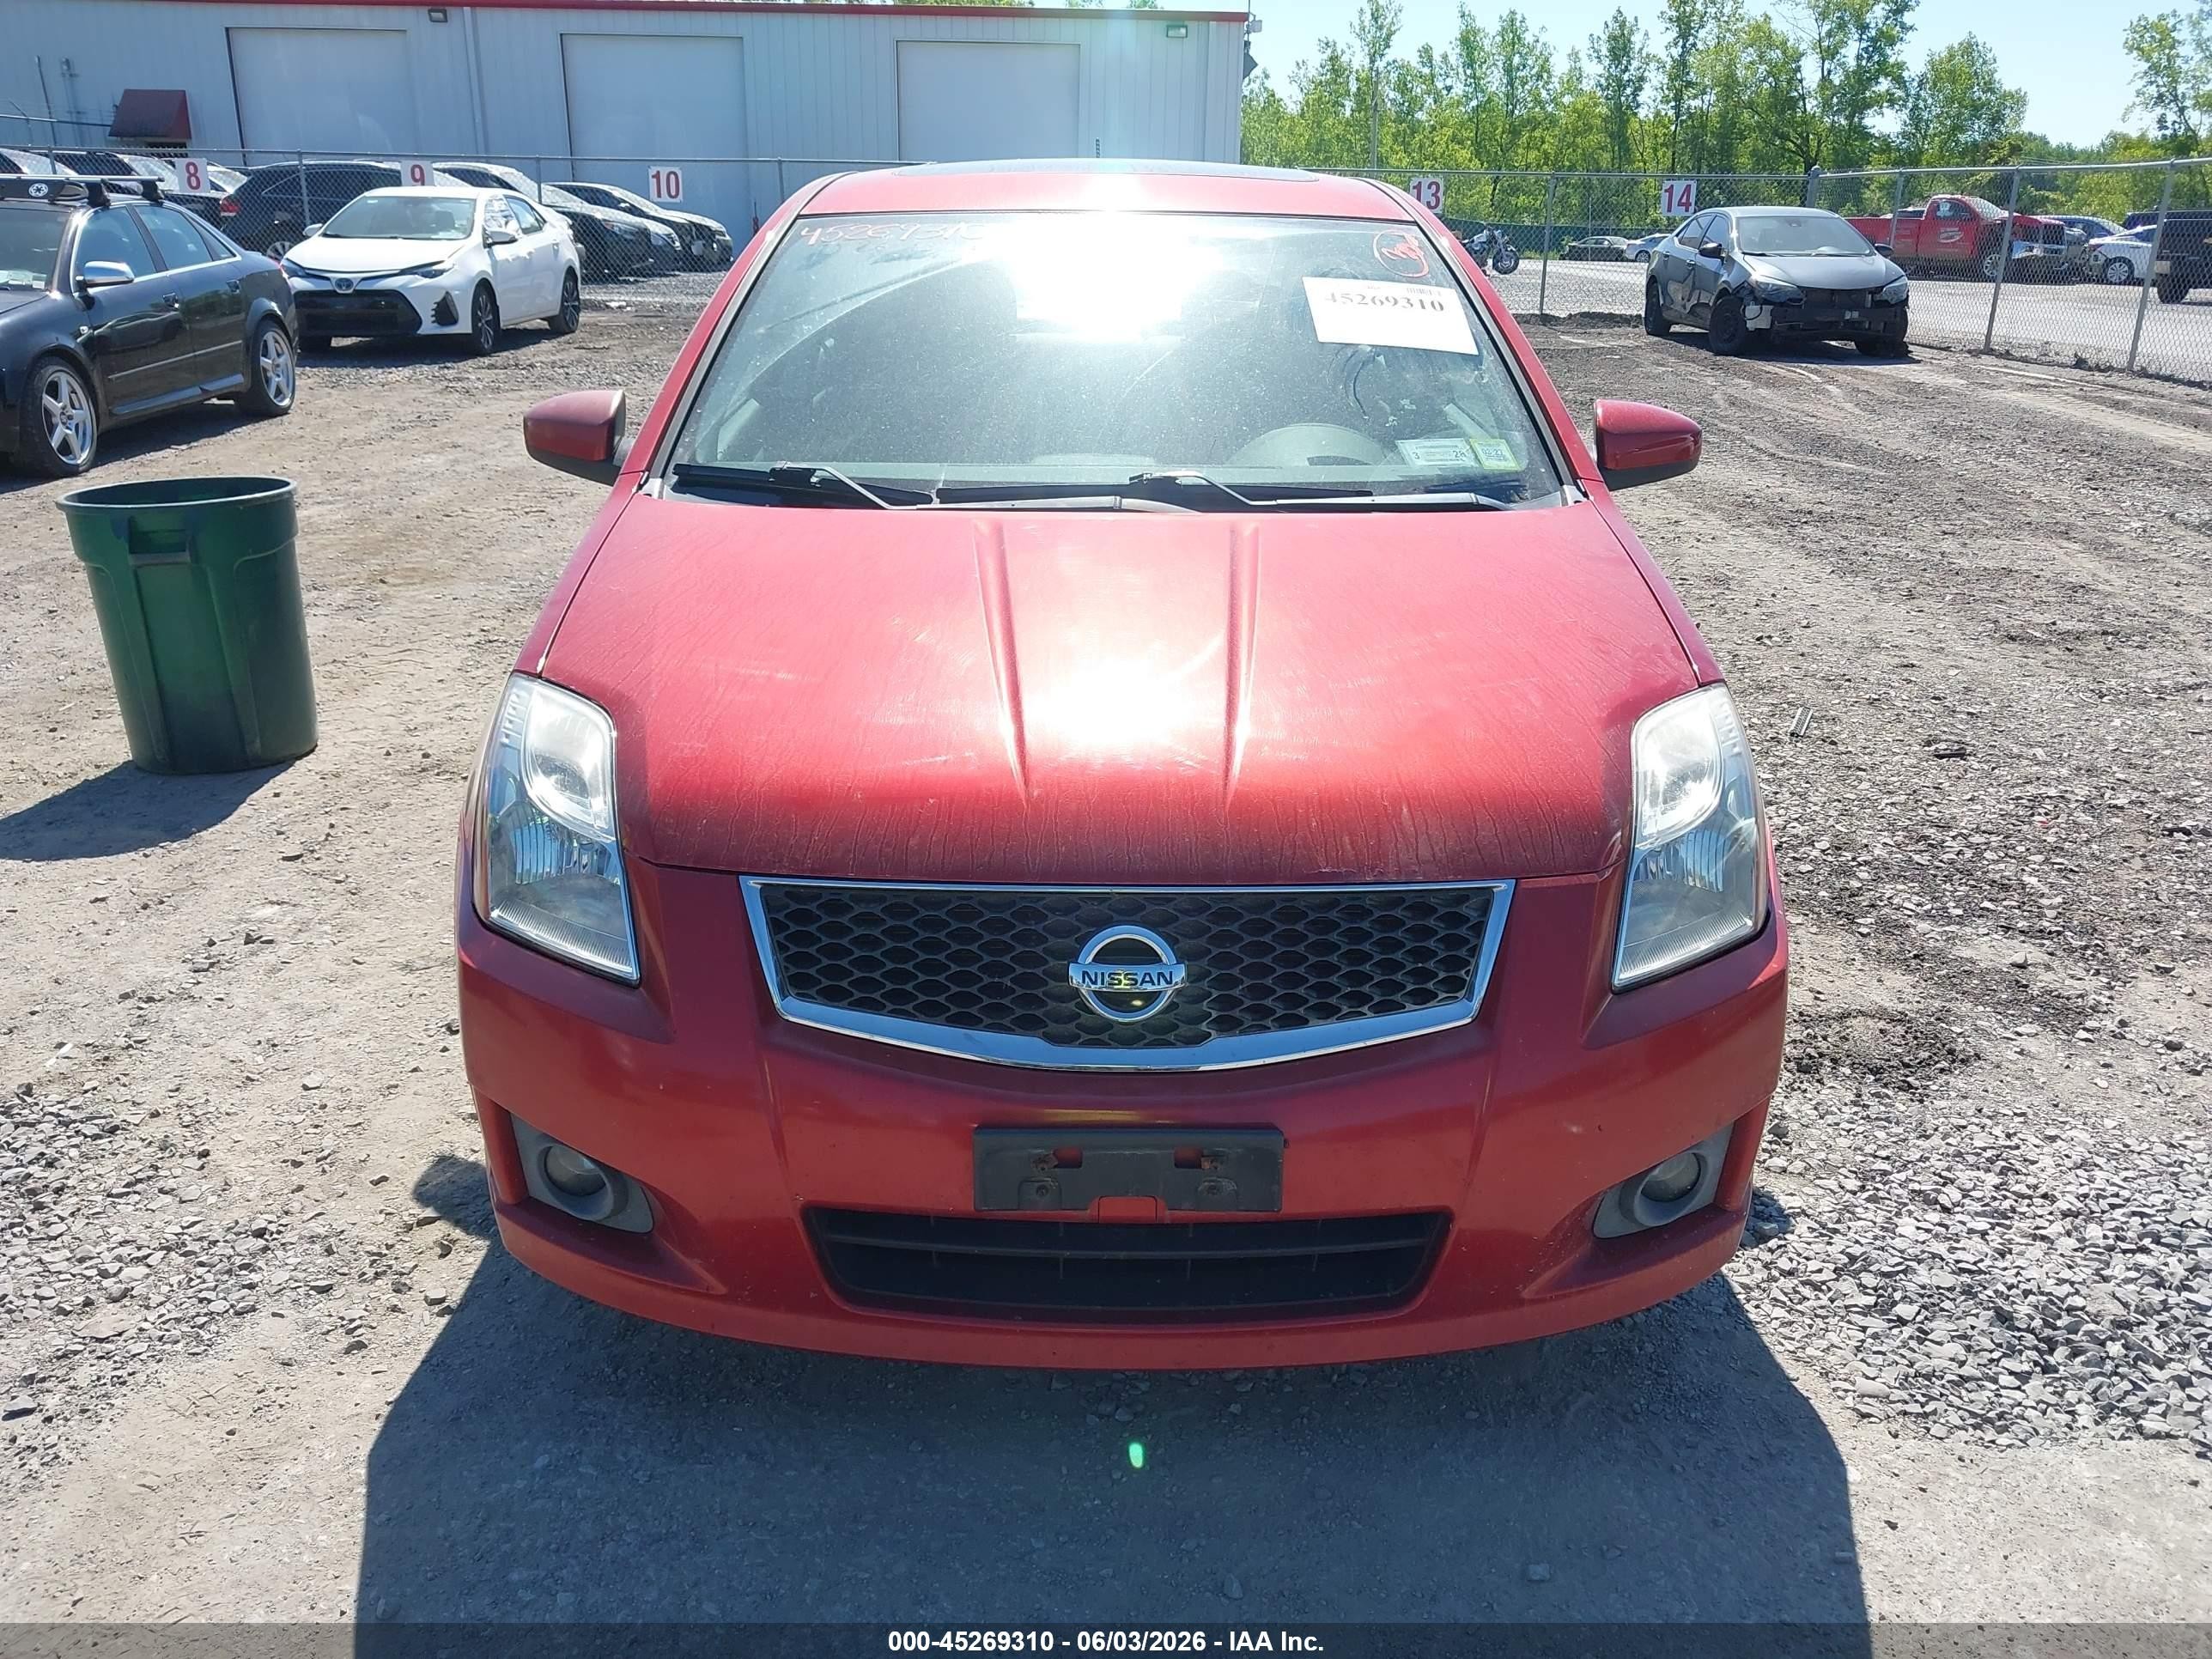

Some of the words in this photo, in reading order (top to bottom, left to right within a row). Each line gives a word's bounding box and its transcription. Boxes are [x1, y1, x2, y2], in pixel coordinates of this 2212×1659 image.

[185, 161, 202, 191] 8
[410, 164, 426, 186] 9
[651, 170, 681, 199] 10
[1412, 180, 1441, 210] 13
[1664, 184, 1692, 213] 14
[1325, 291, 1445, 312] 45269310
[1081, 970, 1173, 987] NISSAN
